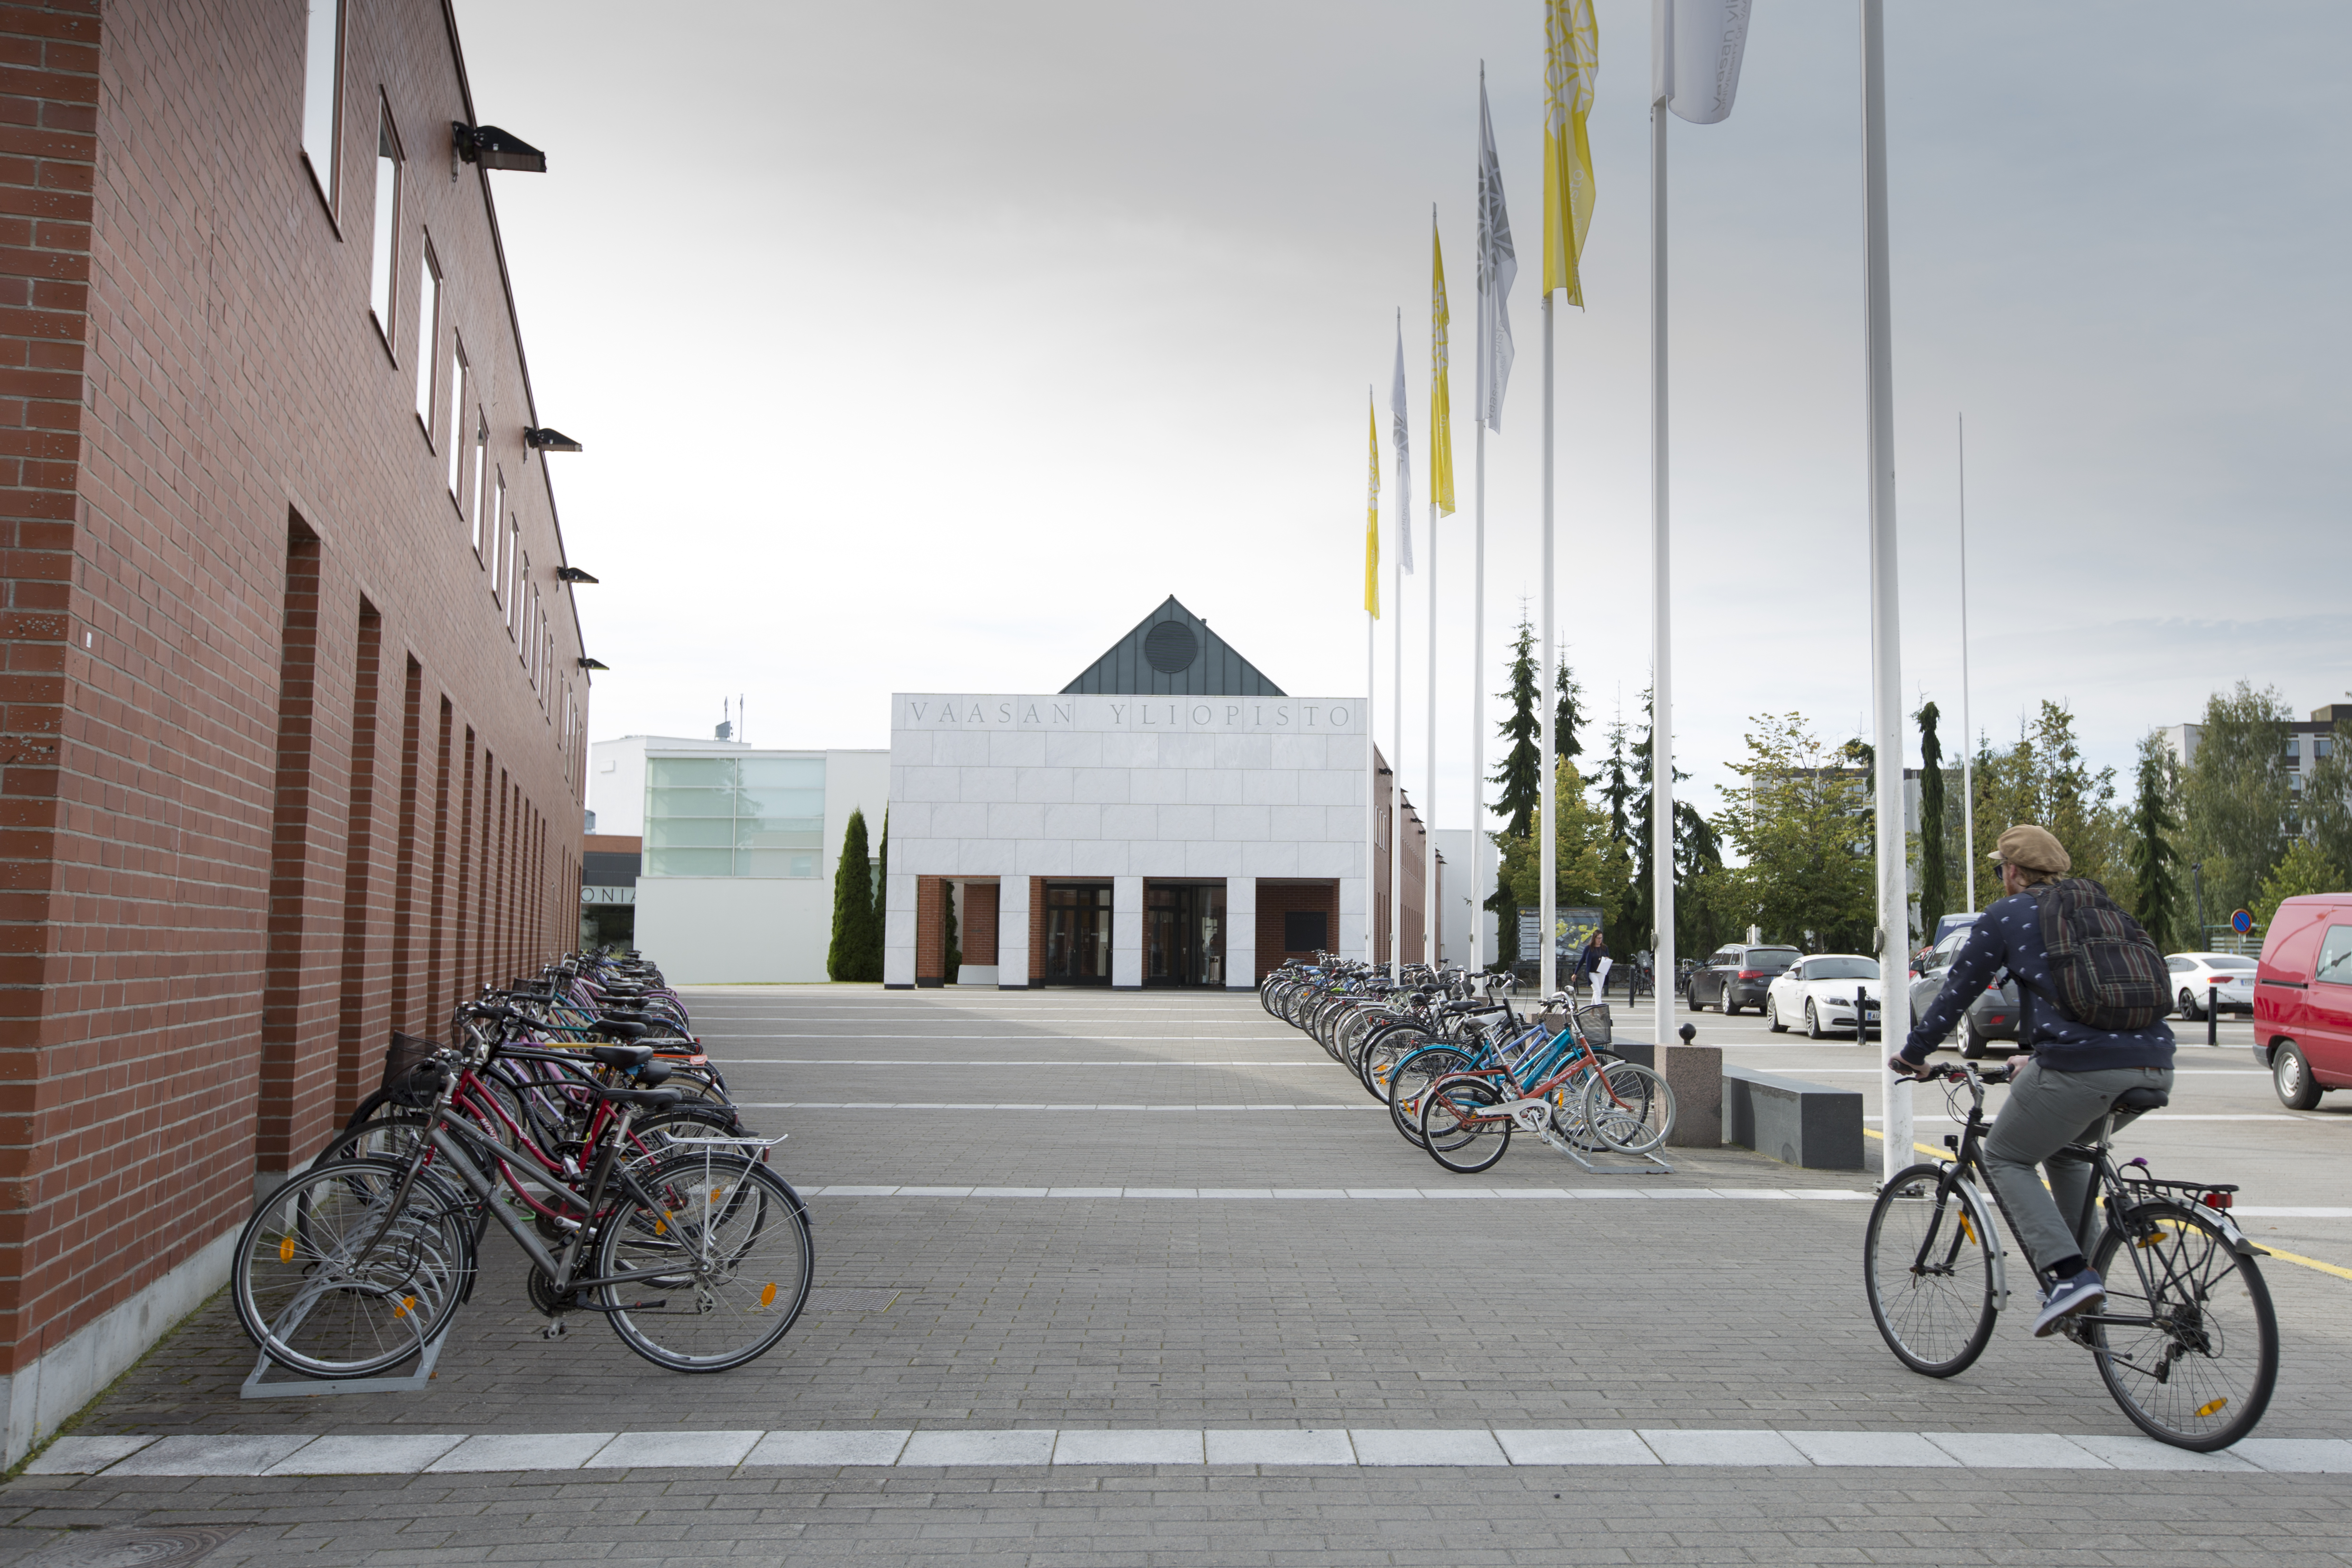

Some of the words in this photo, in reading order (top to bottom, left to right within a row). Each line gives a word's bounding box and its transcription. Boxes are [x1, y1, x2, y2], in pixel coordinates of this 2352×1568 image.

[1711, 29, 1735, 113] Vaasan
[1722, 43, 1738, 110] UNIVERSITY
[1735, 24, 1743, 39] OF
[1497, 355, 1507, 378] VAASA
[910, 702, 1072, 724] VAASAN
[1110, 704, 1349, 727] YLIOPISTO
[1512, 1048, 1532, 1070] SCOTT
[1559, 1070, 1572, 1080] PONI
[476, 1134, 485, 1142] TX
[479, 1118, 499, 1142] MONT
